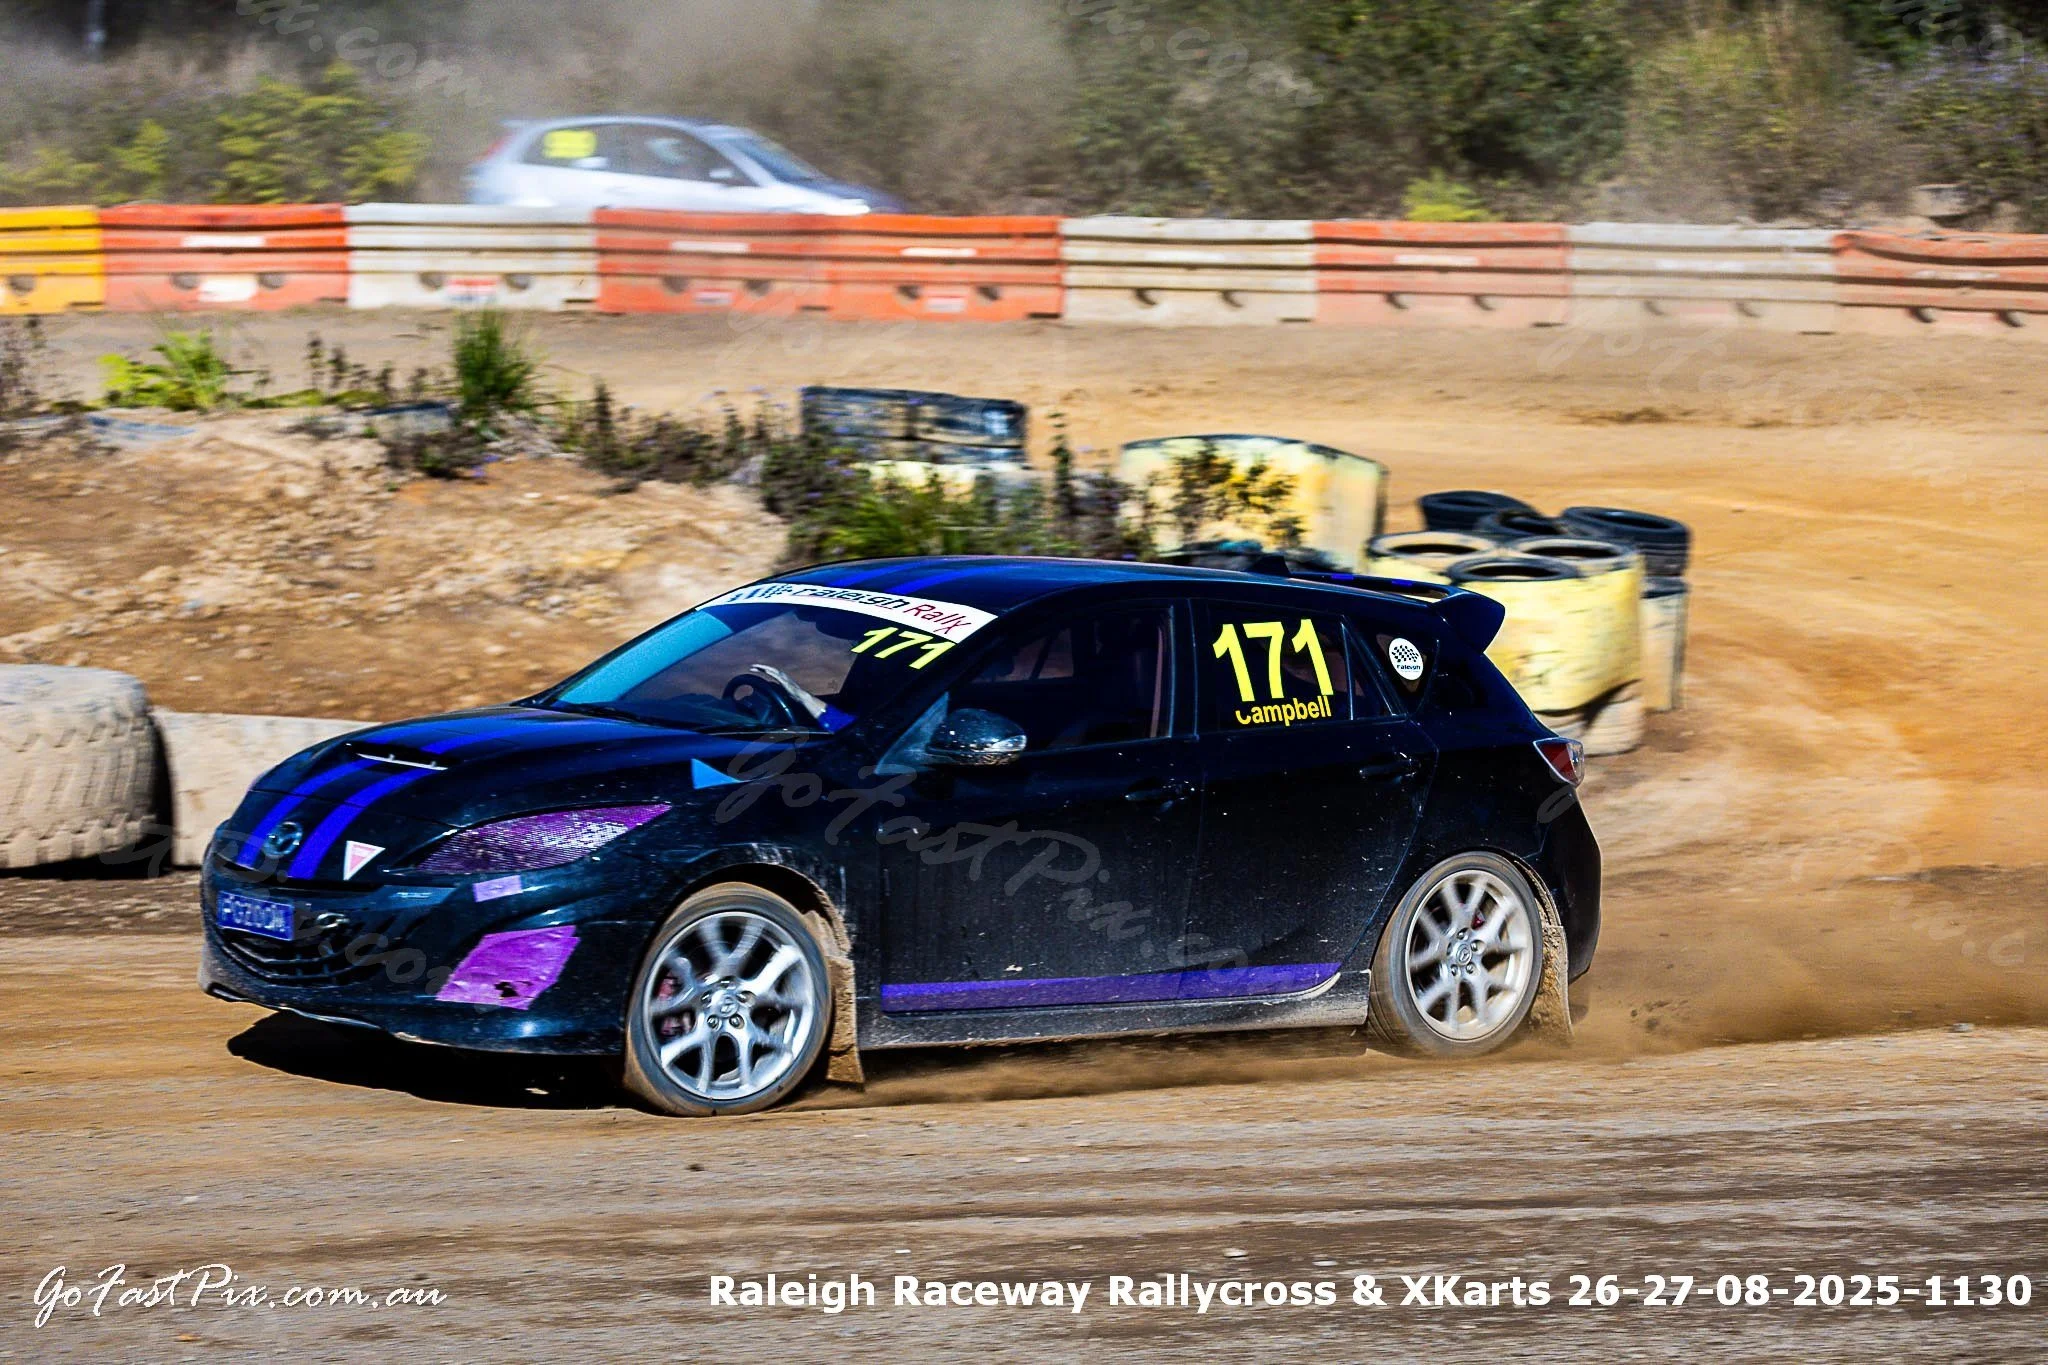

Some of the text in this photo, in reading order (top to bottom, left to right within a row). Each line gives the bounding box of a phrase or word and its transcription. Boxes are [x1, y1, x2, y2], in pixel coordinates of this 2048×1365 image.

[793, 587, 909, 610] raleigh
[903, 604, 972, 634] Rally
[851, 626, 956, 670] 171
[1212, 618, 1334, 702] 171
